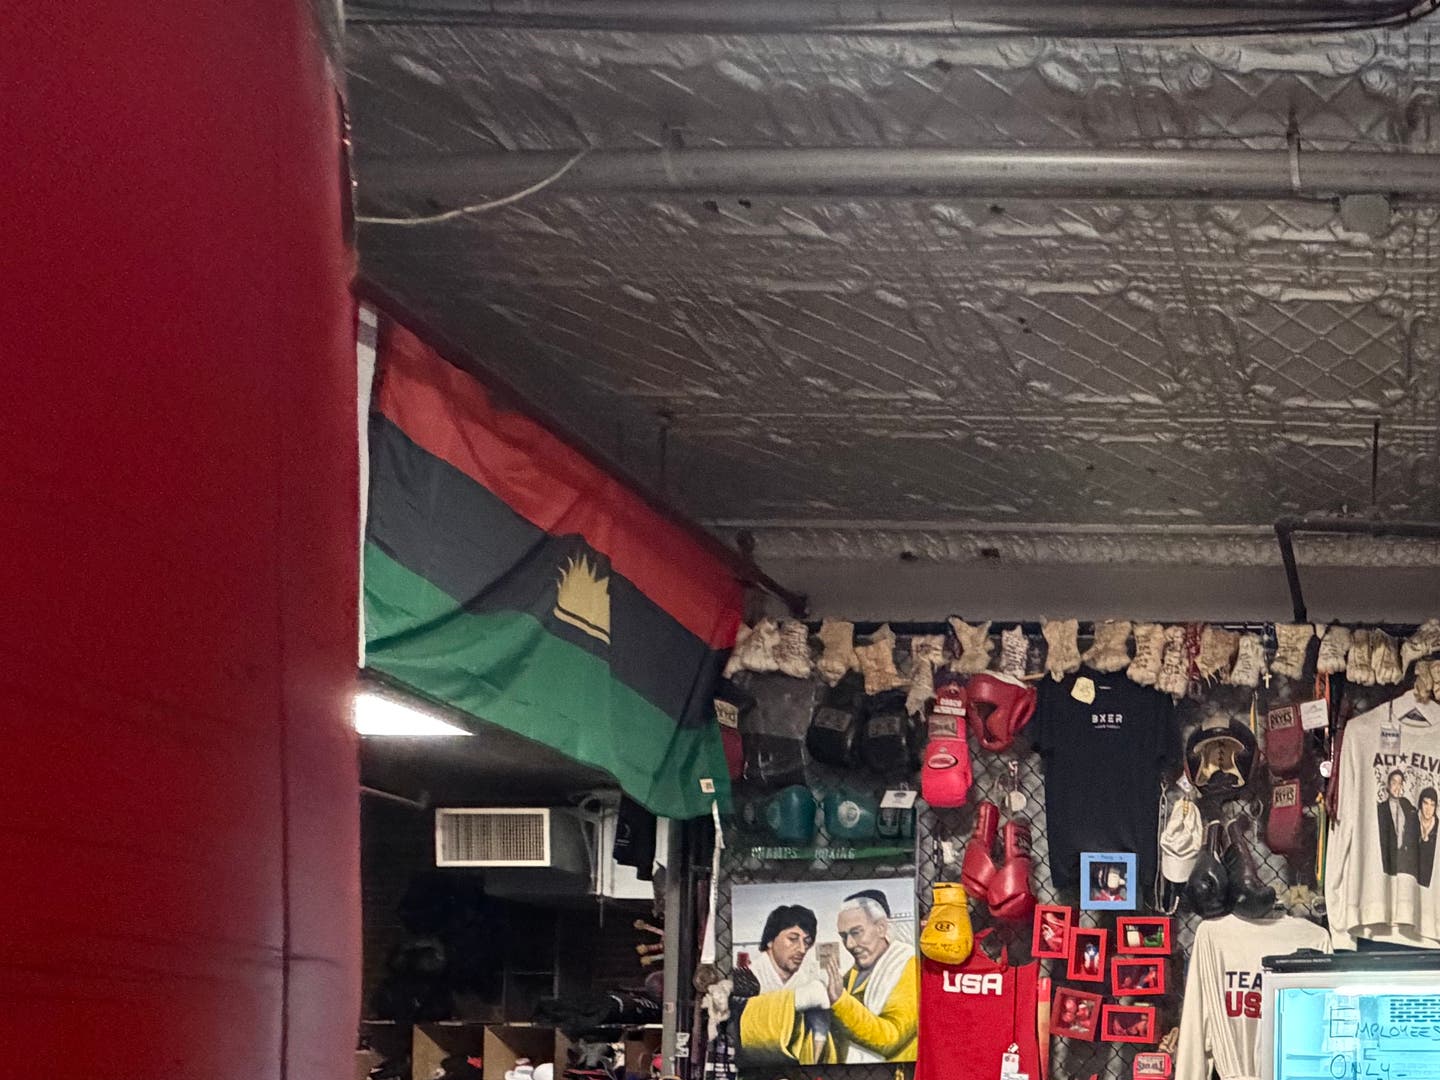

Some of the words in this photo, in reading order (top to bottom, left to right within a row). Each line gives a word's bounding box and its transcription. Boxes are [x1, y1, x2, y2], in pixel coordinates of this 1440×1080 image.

[1092, 713, 1123, 724] BXER
[1373, 752, 1397, 768] ALT
[943, 970, 1003, 995] USA
